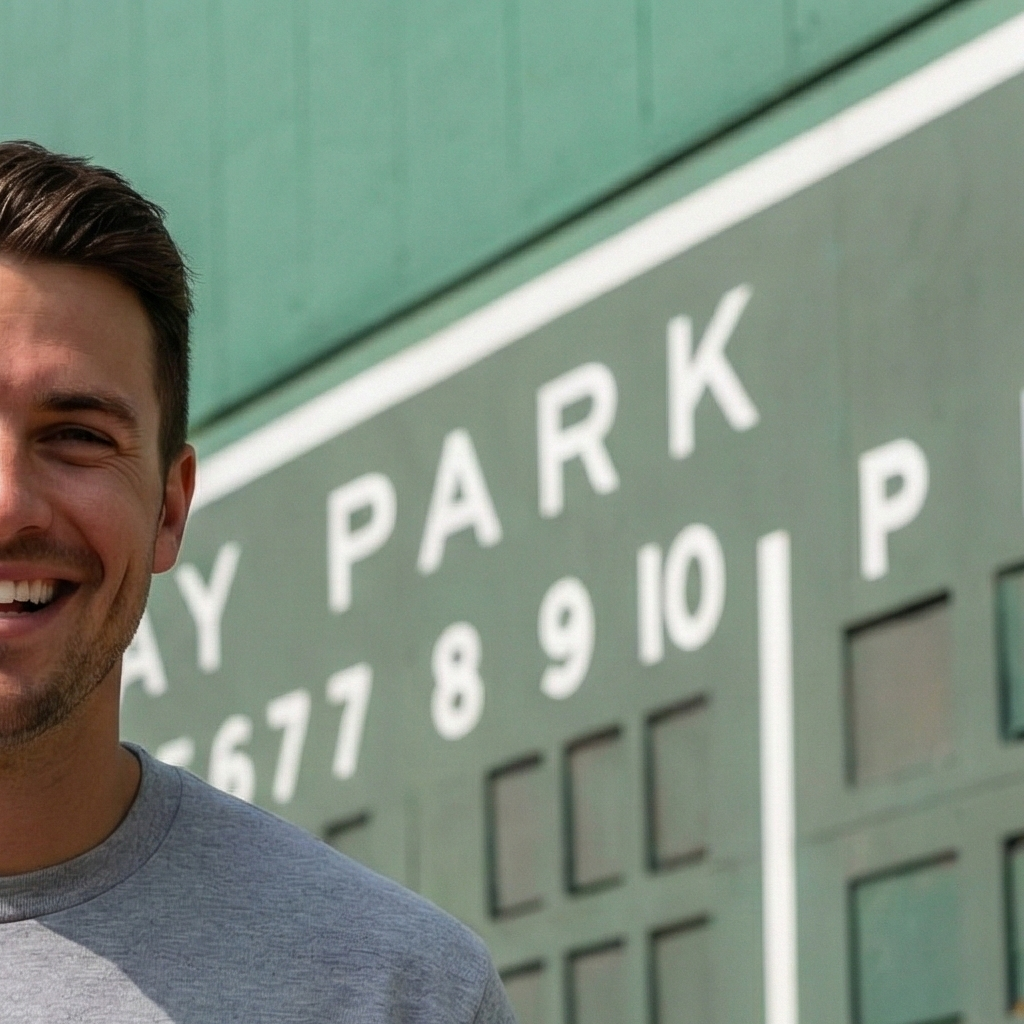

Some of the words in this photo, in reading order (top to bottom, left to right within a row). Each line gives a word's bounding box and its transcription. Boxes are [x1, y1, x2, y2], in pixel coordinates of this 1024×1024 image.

[327, 283, 760, 614] PARK
[858, 437, 930, 580] P
[431, 621, 486, 740] 8
[537, 576, 596, 700] 9
[636, 522, 727, 666] 10
